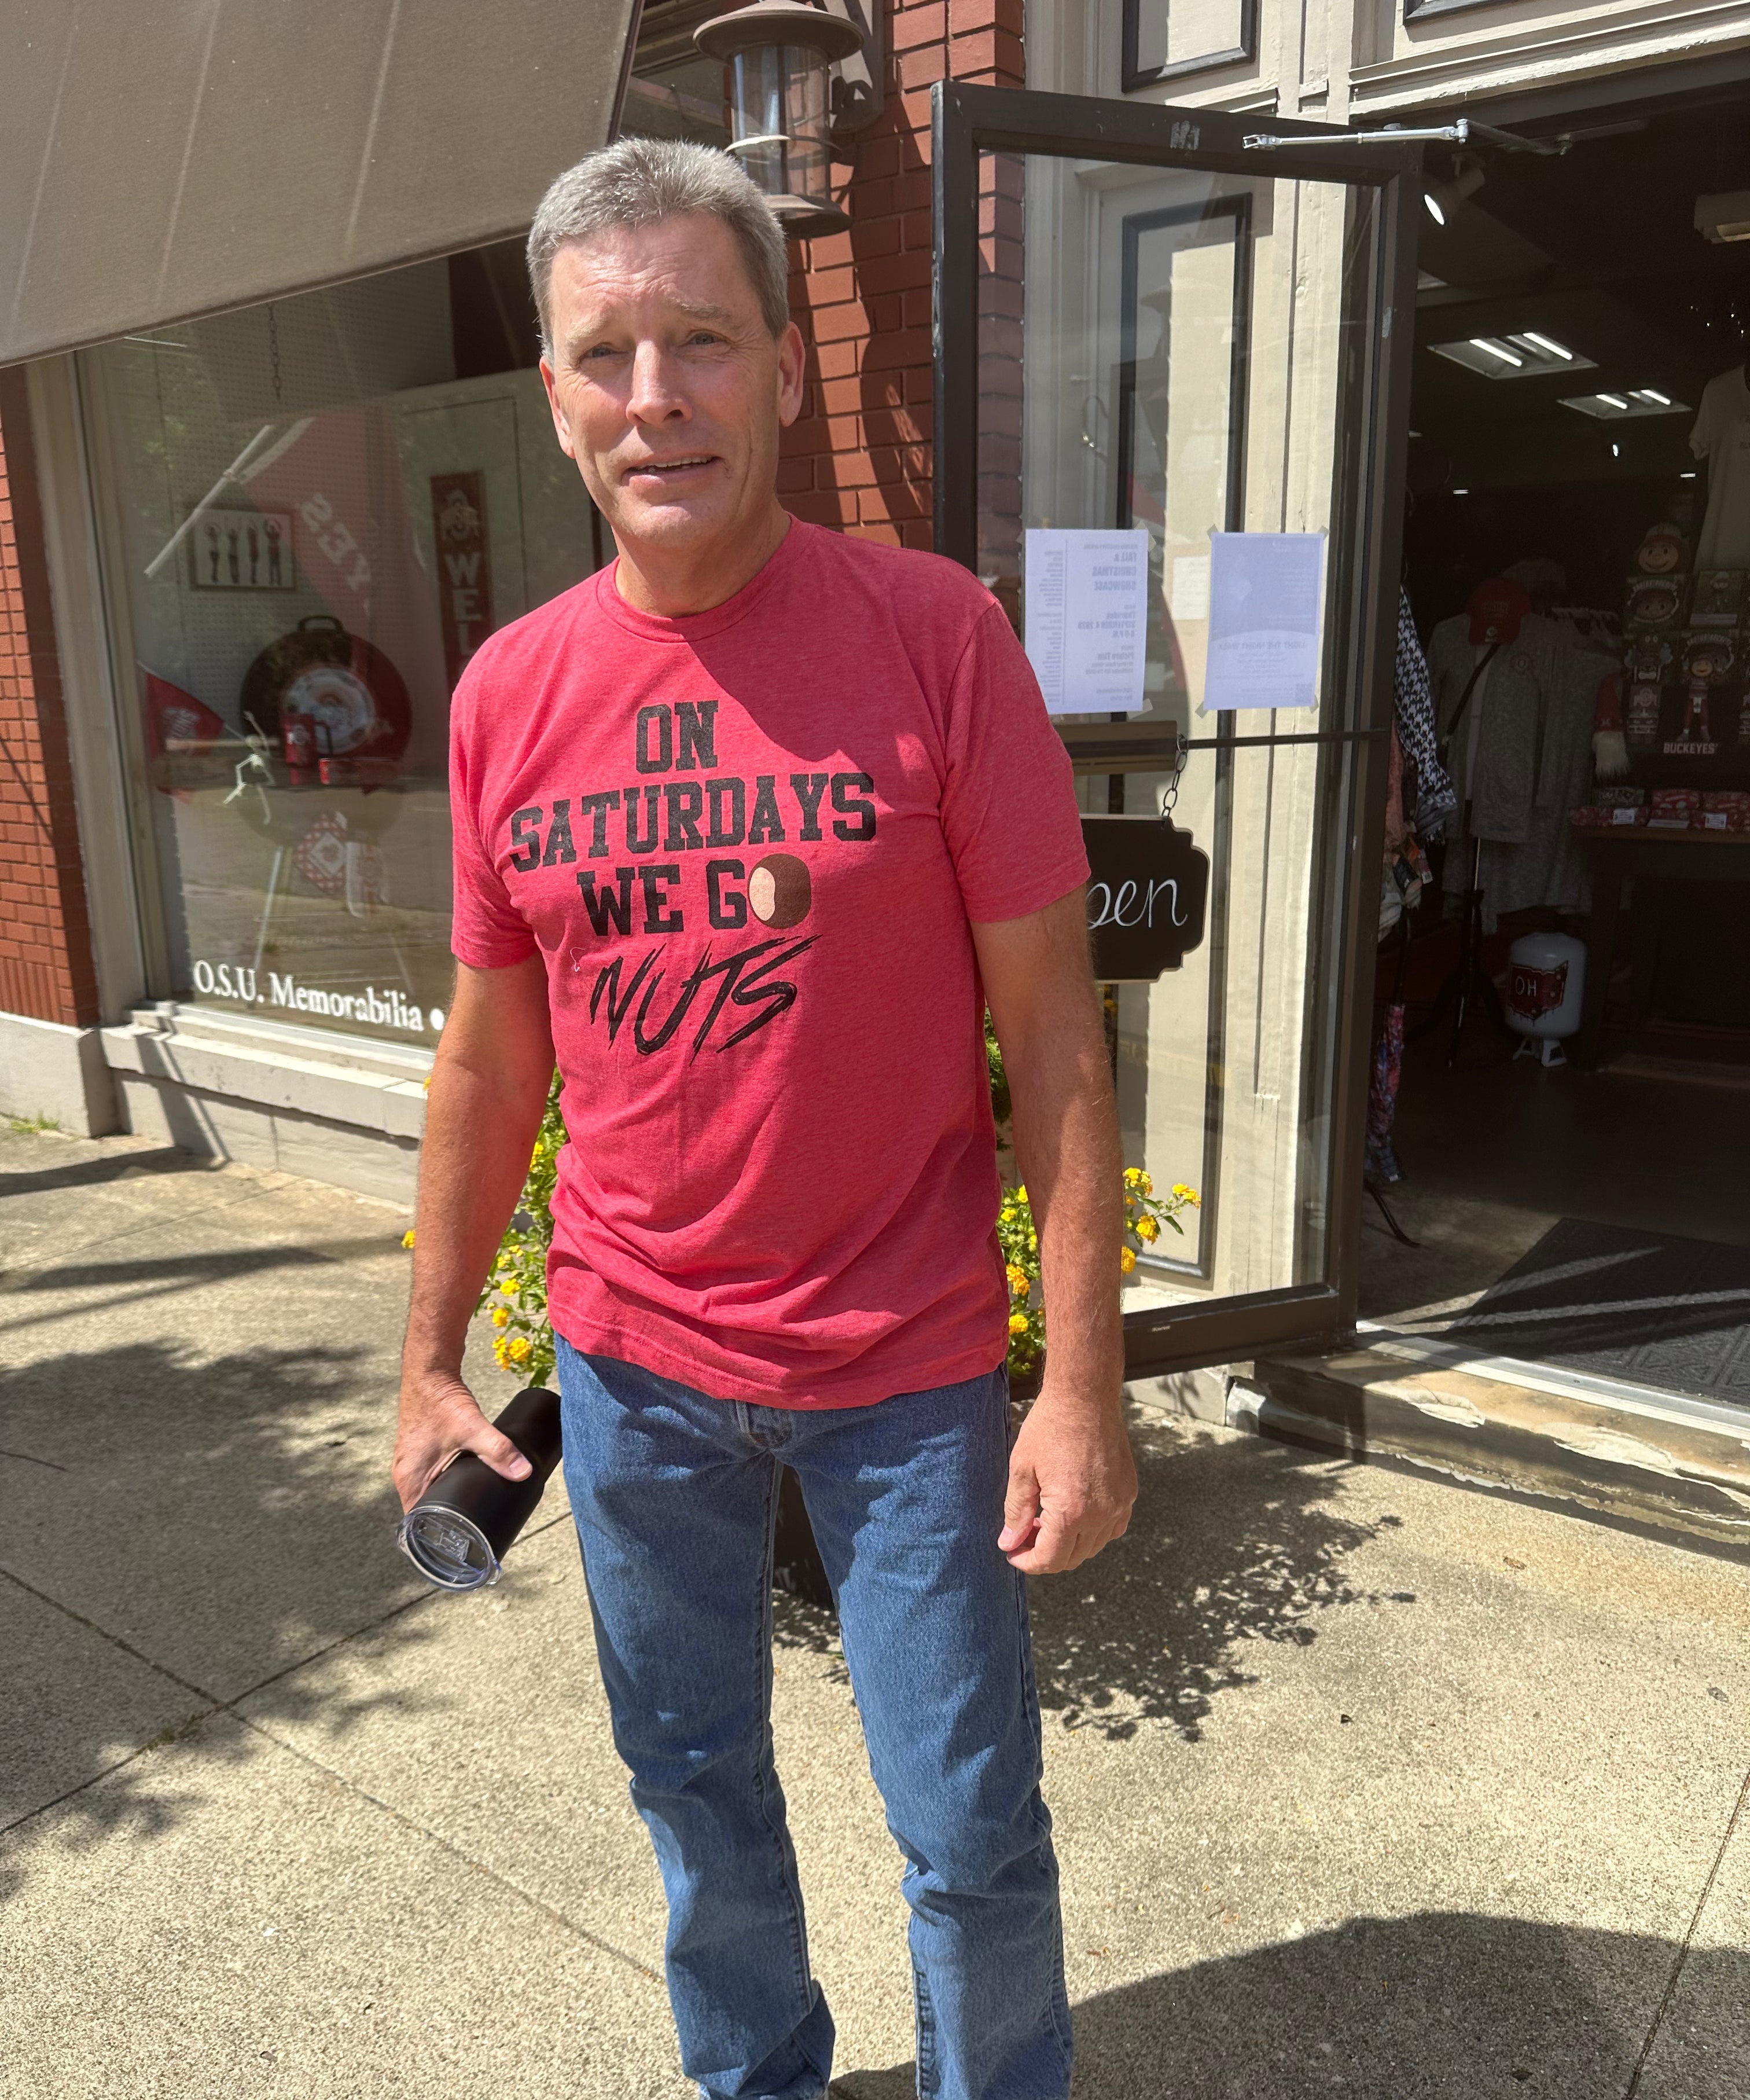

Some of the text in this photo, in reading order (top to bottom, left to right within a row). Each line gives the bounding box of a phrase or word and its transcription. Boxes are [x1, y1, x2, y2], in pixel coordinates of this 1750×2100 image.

[636, 700, 719, 774] ON
[1663, 741, 1716, 755] BUCKEYES
[509, 772, 877, 873] SATURDAYS
[576, 864, 684, 937] WE
[193, 960, 424, 1031] O.S.U. Memorabilia
[590, 934, 823, 1067] NUTS
[1514, 976, 1537, 997] OH
